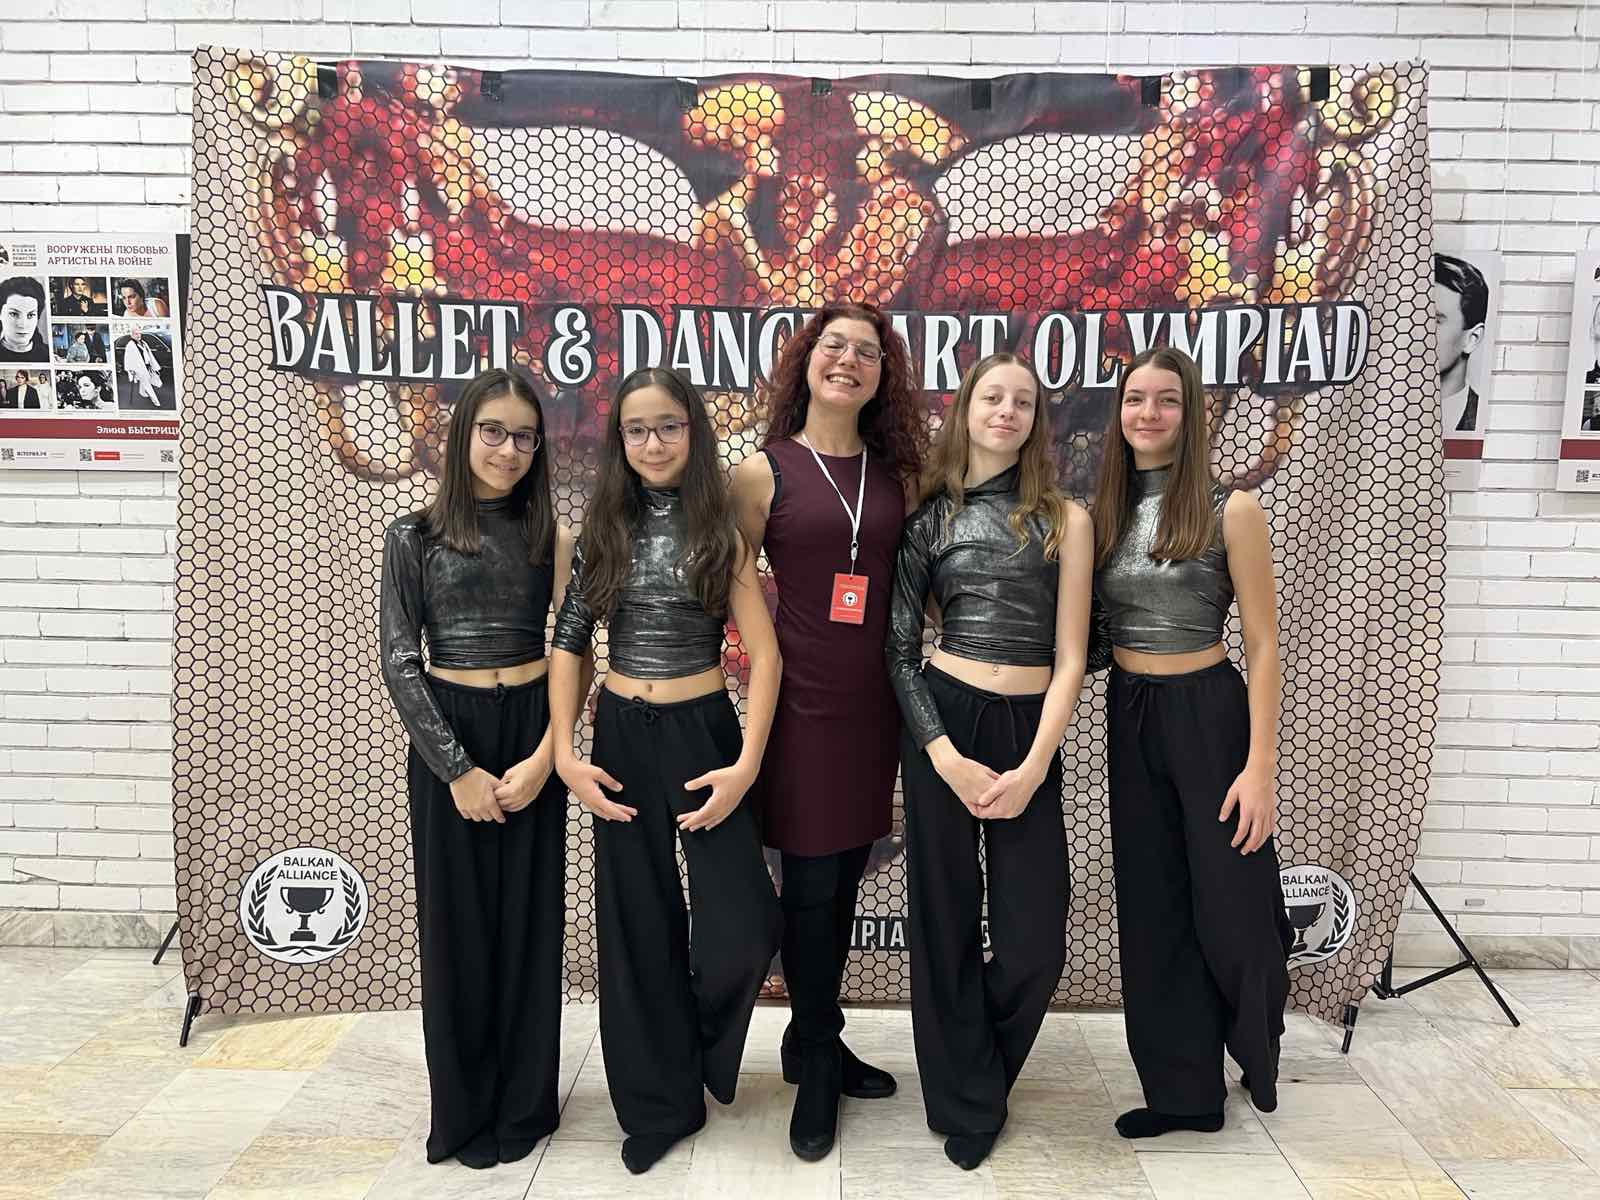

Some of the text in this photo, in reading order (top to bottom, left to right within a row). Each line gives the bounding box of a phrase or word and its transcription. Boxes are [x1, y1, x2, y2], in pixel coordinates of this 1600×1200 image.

[47, 245, 169, 255] ВООРУЖЕНЫ ЛЮБОВЬЮ
[47, 255, 153, 266] АРТИСТЫ НА ВОЙНЕ
[264, 288, 519, 379] BALLET
[548, 307, 592, 384] &
[620, 308, 814, 388] DANC
[1033, 305, 1368, 389] OLYMPIAD
[96, 425, 126, 435] Элина
[283, 856, 334, 867] BALKAN
[277, 869, 338, 880] ALLIANCE
[1282, 874, 1329, 885] BALKAN
[1284, 885, 1330, 898] LLIANCE
